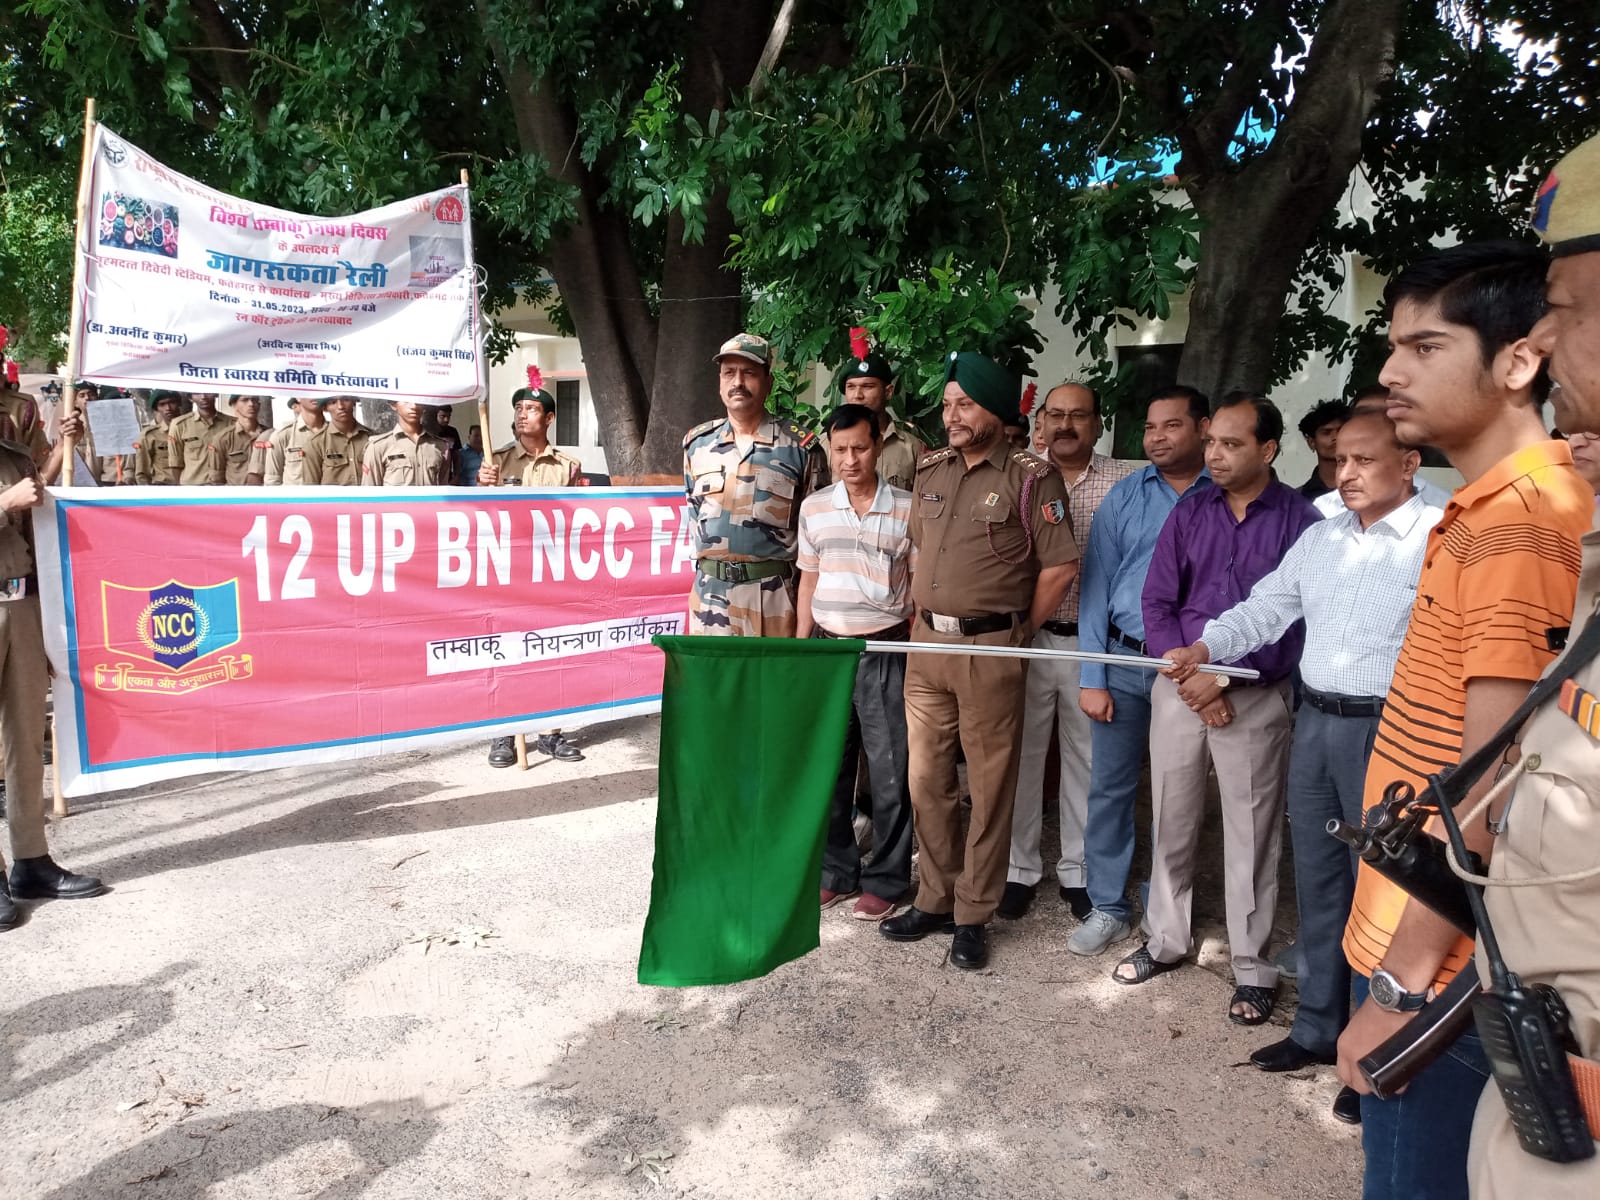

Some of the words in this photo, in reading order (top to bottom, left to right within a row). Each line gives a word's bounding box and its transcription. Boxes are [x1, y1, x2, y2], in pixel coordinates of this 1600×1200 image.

[350, 222, 388, 240] दिवस
[337, 259, 389, 288] रैली
[251, 299, 308, 315] 31.05.2023,
[153, 331, 188, 348] कुमार)
[295, 342, 319, 352] कुमार
[429, 348, 453, 361] कुमार
[179, 362, 219, 380] जिला
[273, 369, 317, 386] समिति
[242, 514, 316, 602] 12
[336, 512, 416, 597] UP
[436, 510, 511, 589] BN
[531, 506, 635, 583] NCC
[152, 612, 195, 639] NCC
[430, 633, 506, 661] तम्बाकू
[522, 631, 603, 657] नियन्त्रण
[127, 676, 153, 688] एकता
[156, 675, 176, 689] और
